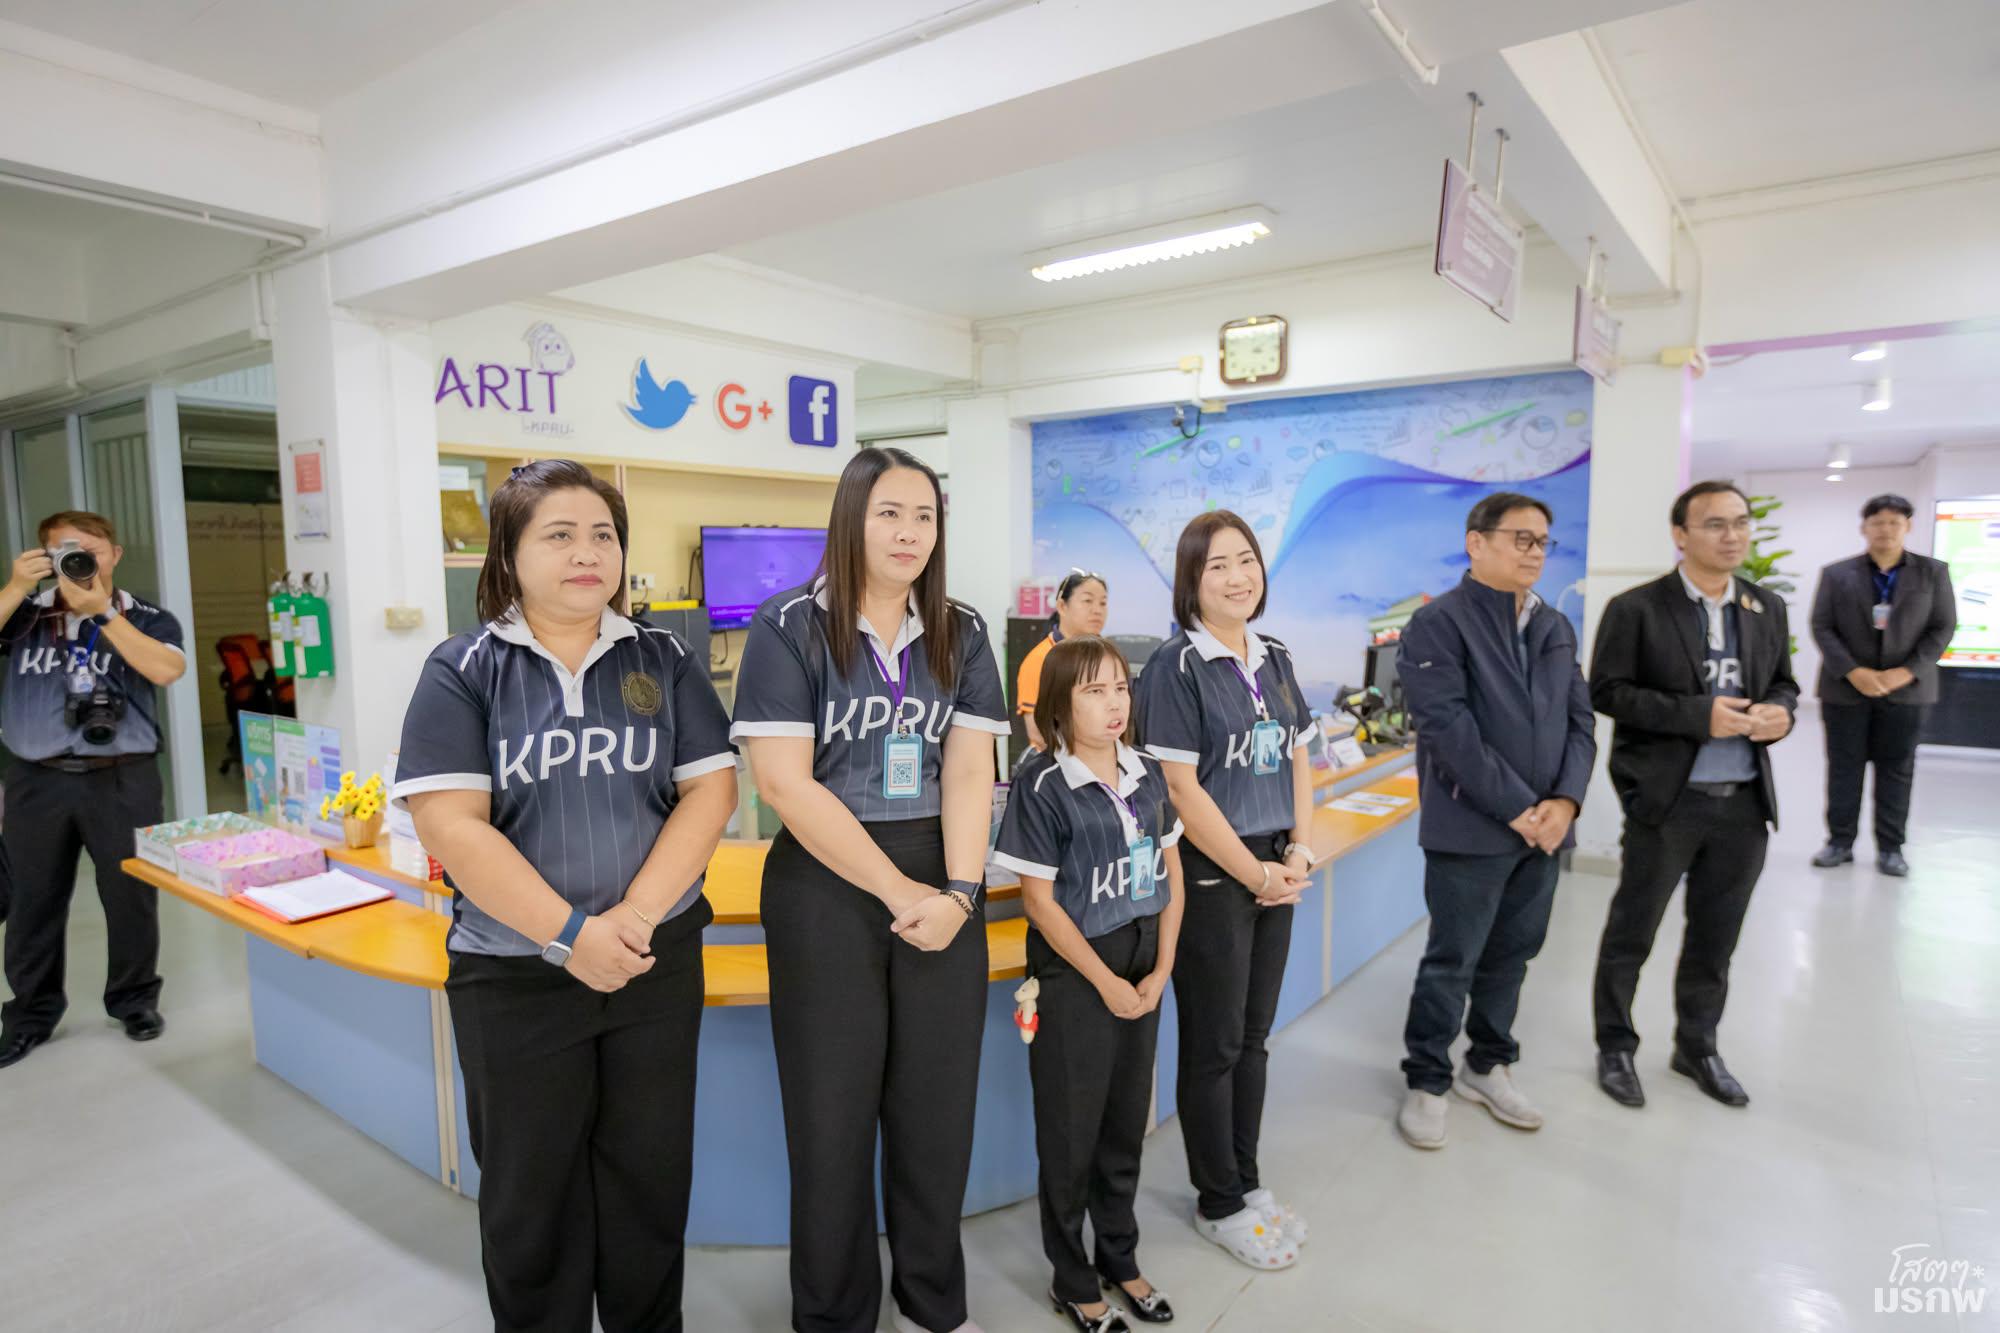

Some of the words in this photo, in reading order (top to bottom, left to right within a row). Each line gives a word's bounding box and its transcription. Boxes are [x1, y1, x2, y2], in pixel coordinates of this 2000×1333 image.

[435, 357, 562, 414] ARIT
[823, 695, 954, 744] KPRU
[498, 726, 657, 791] KPRU
[1091, 848, 1168, 904] KPU
